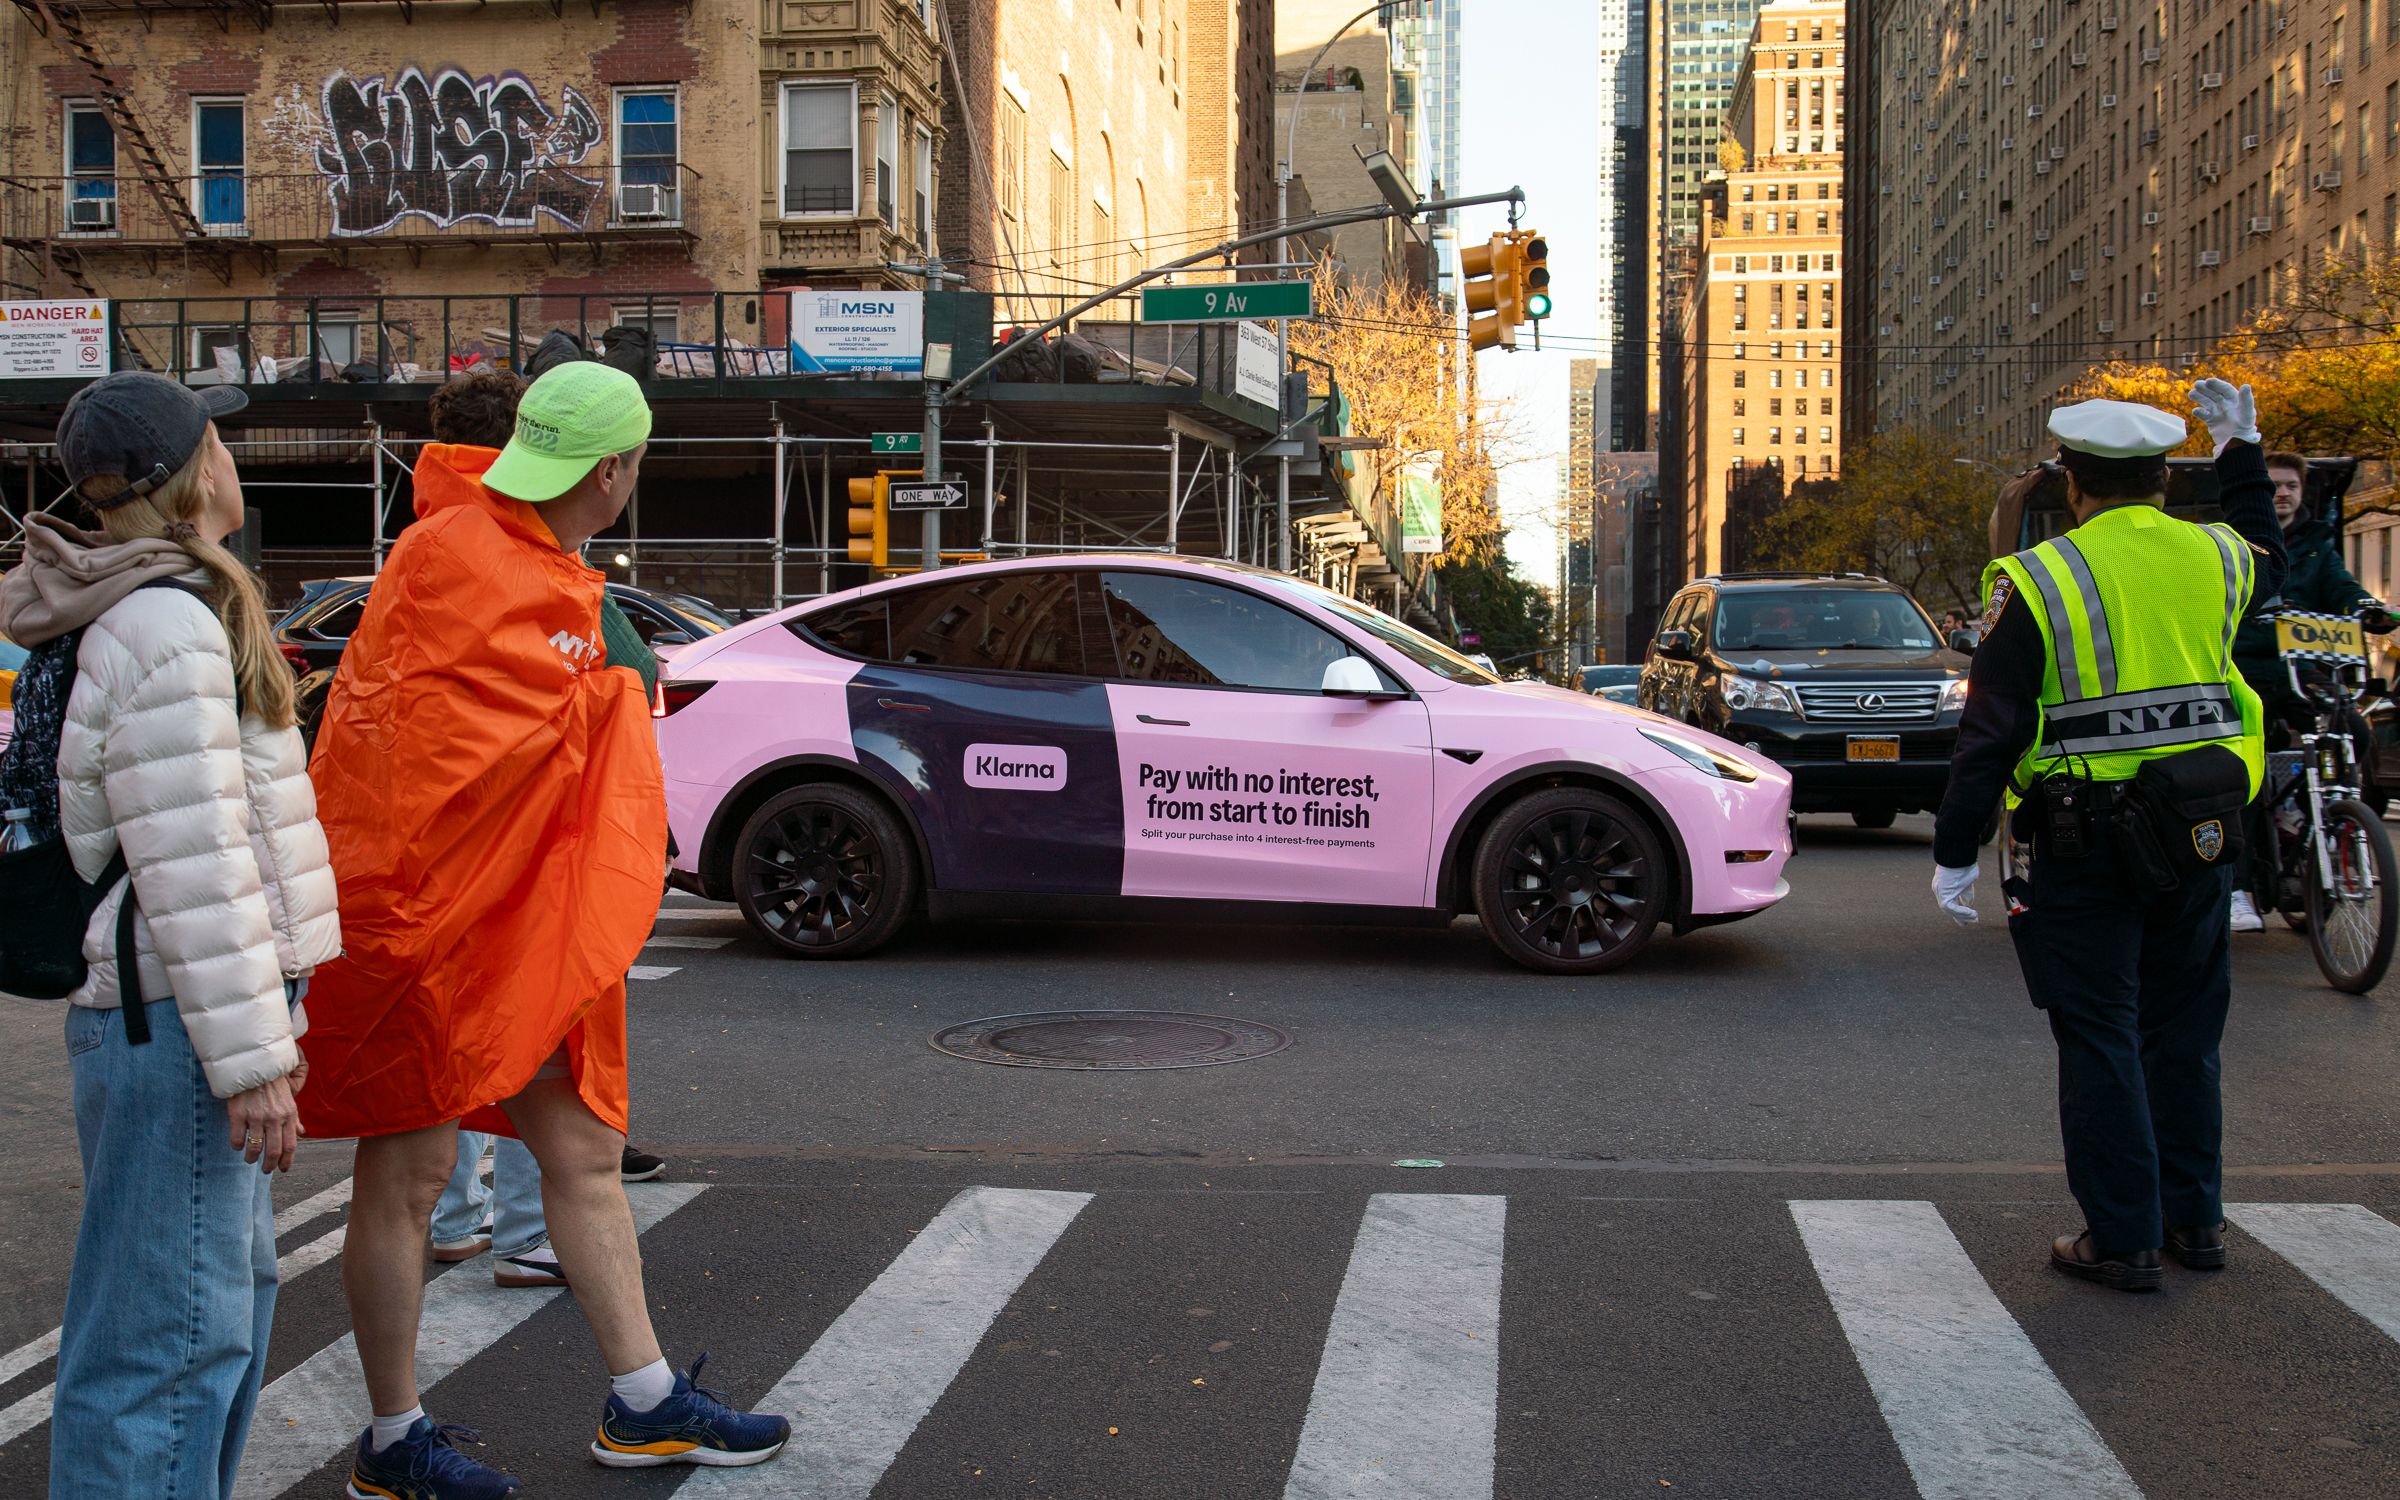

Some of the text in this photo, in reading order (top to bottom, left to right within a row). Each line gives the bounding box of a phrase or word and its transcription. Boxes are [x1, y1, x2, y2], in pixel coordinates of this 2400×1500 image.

[841, 302, 895, 314] MSN
[1204, 291, 1248, 314] 9 Av
[11, 306, 87, 321] DANGER
[79, 335, 99, 343] AREA
[1250, 330, 1261, 346] West
[824, 357, 921, 365] msnconstructioninc@gmail.com
[541, 424, 561, 434] run.
[885, 435, 896, 450] 9
[901, 490, 955, 501] ONE WAY
[2291, 623, 2353, 645] TAXI
[975, 755, 1055, 779] Klarna
[1139, 763, 1380, 802] Pay with no interest,
[1147, 793, 1370, 829] from start to finish
[1141, 828, 1375, 849] Split your purchase into 4 interest-free payments
